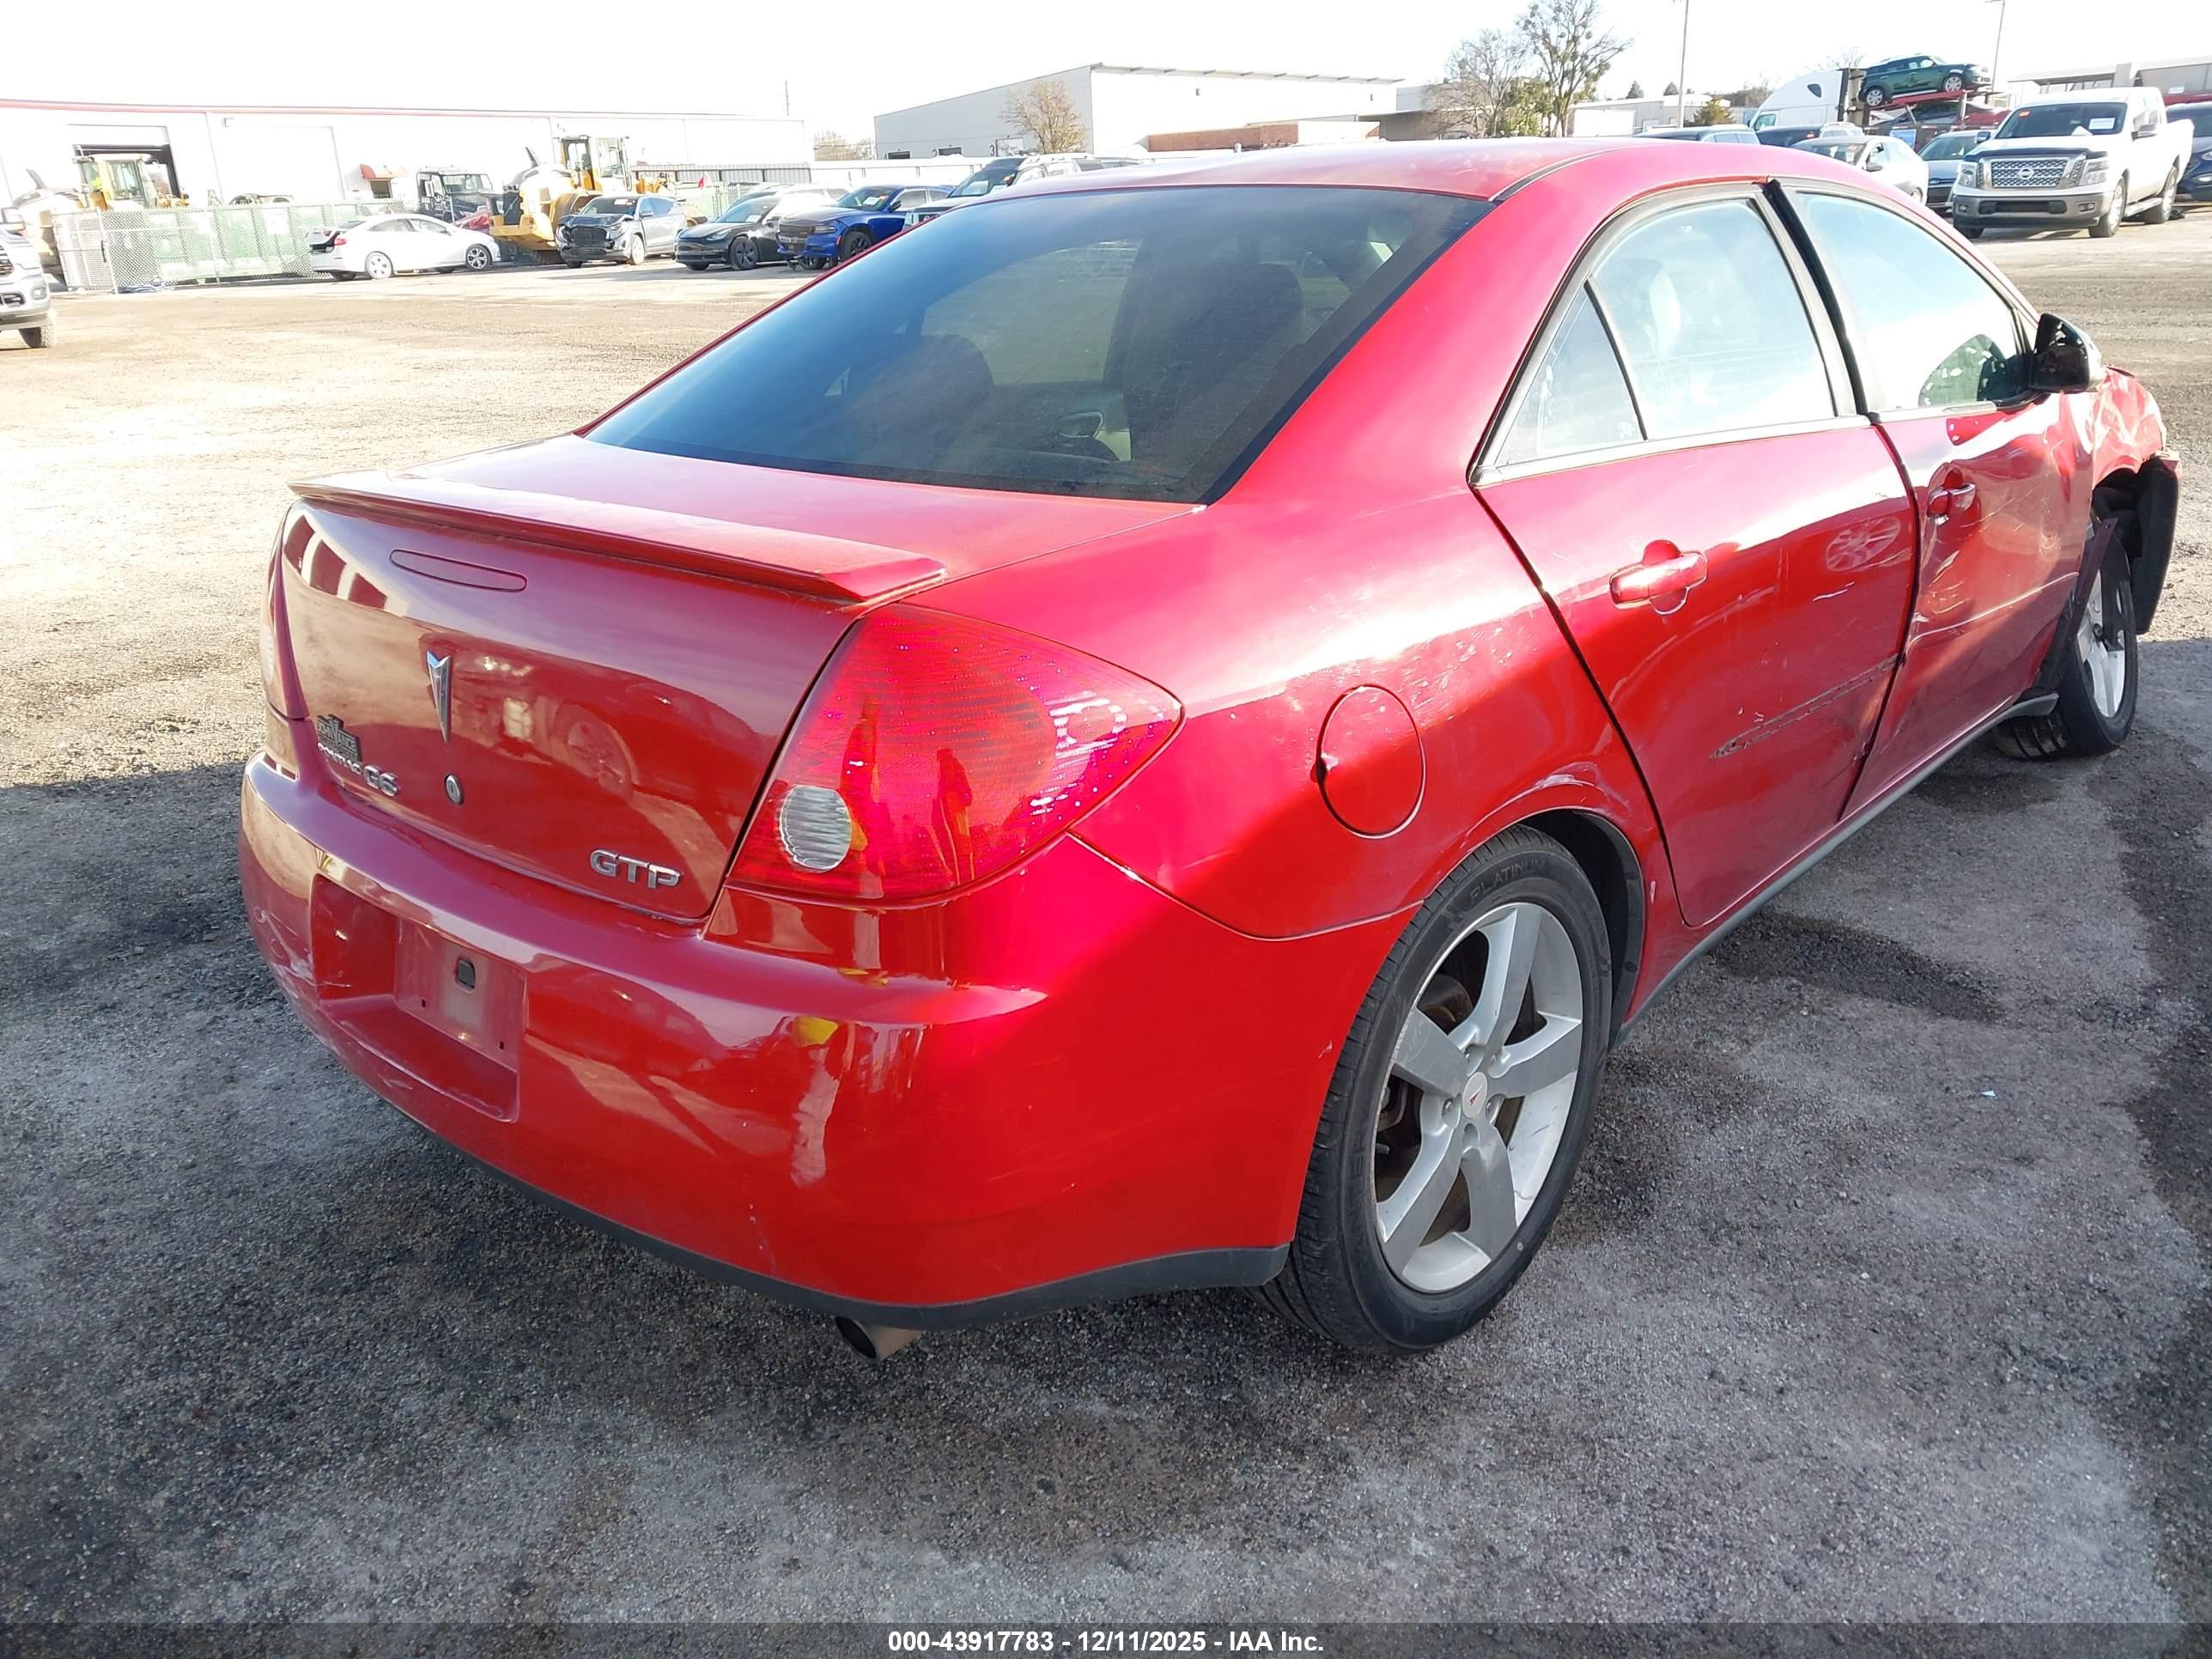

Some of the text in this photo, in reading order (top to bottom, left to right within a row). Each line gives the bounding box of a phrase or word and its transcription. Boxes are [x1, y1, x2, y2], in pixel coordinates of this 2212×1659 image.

[989, 144, 995, 157] 3
[317, 743, 362, 775] PONTIAC
[363, 764, 398, 797] G6
[590, 848, 681, 889] GTP
